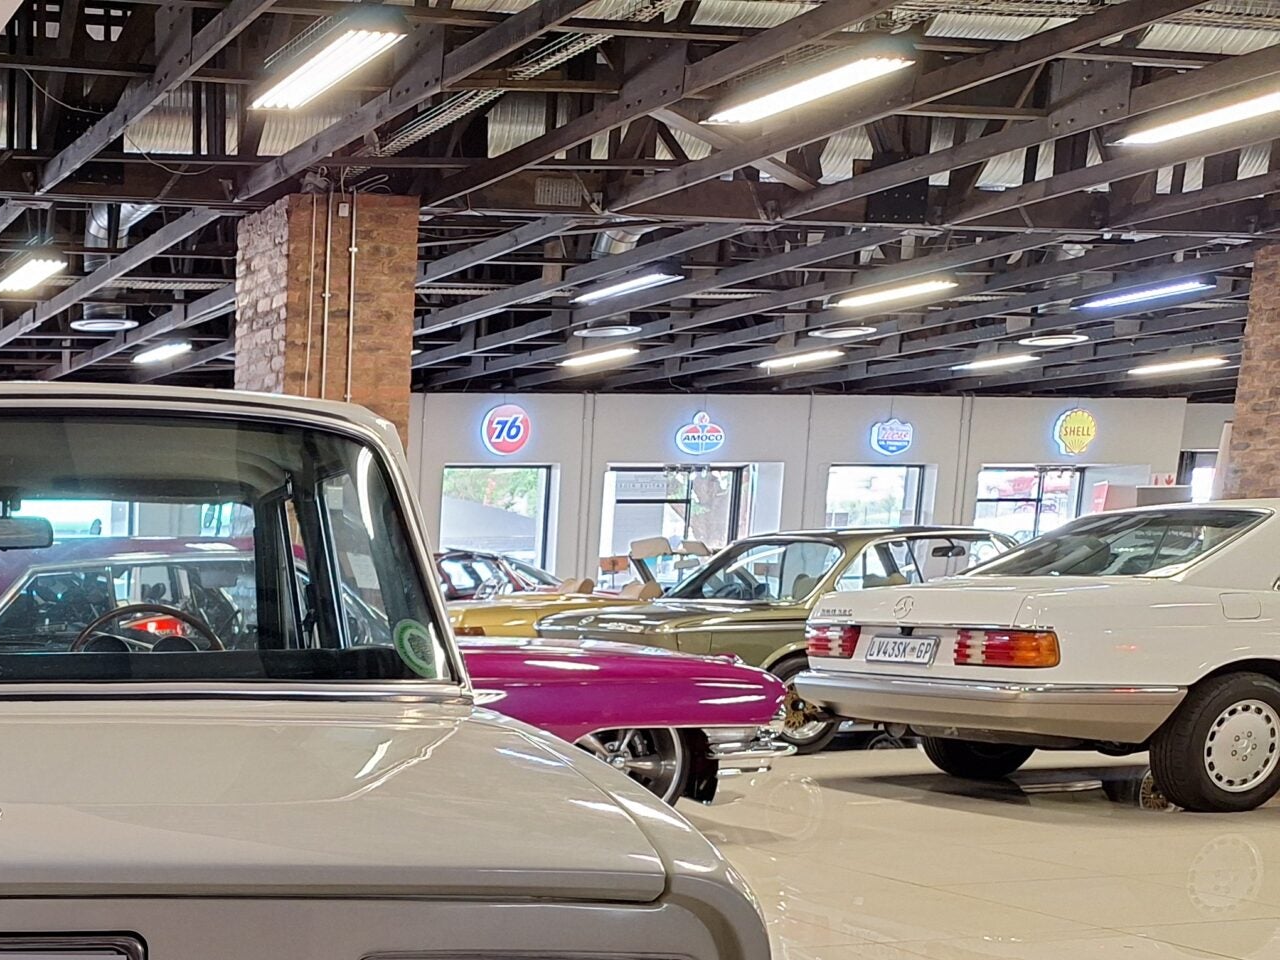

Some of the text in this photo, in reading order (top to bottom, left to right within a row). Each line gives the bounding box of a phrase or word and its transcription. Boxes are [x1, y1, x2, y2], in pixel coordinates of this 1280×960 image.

[492, 415, 523, 442] 76
[1063, 425, 1091, 437] SHELL
[682, 434, 723, 442] AMOCO
[869, 639, 932, 659] LV43SK GP
